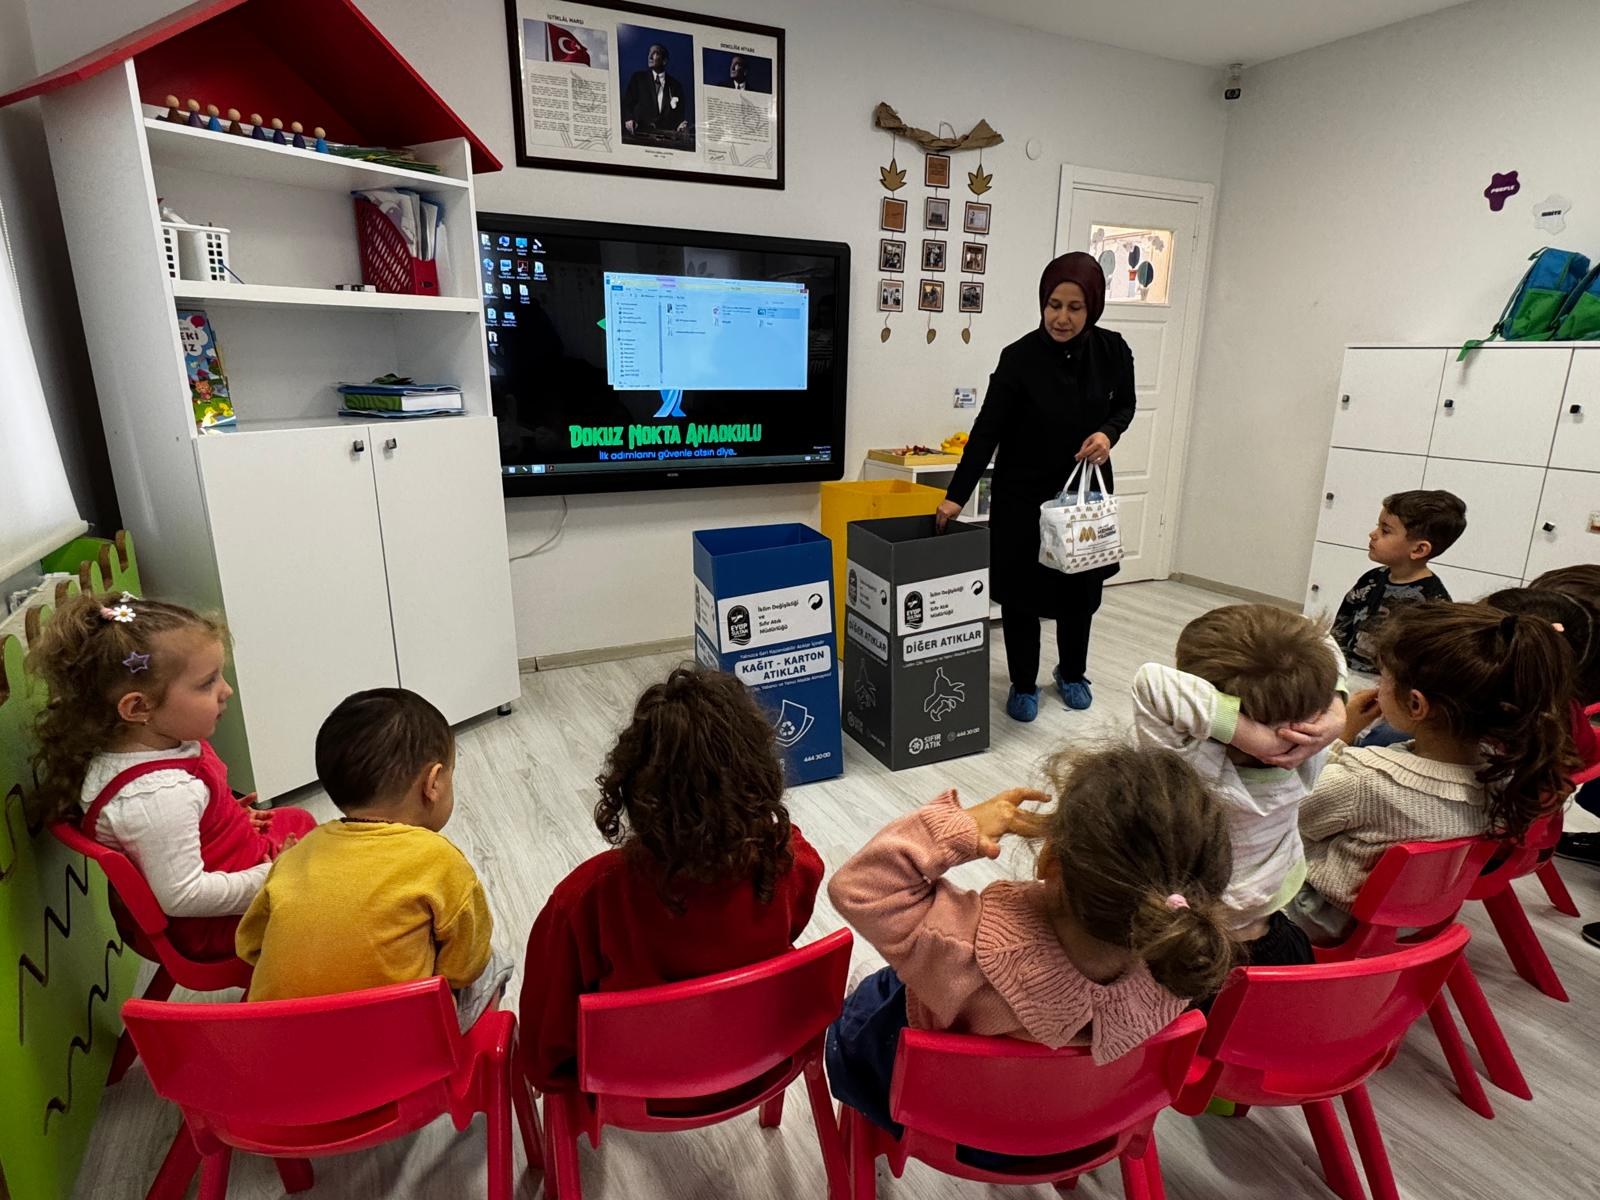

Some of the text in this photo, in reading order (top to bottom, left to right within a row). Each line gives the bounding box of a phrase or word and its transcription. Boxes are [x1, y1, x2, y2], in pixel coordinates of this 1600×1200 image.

[569, 424, 624, 449] DOKUZ
[629, 423, 682, 450] NOKTA
[657, 449, 693, 462] güvenle
[694, 449, 715, 458] atsın
[906, 639, 938, 654] DİĞER
[940, 630, 982, 647] ATIKLAR
[742, 659, 773, 674] KAĞIT
[784, 650, 824, 666] KARTON
[763, 664, 806, 680] ATIKLAR
[924, 733, 941, 743] SIFIR
[924, 741, 941, 750] ATIK
